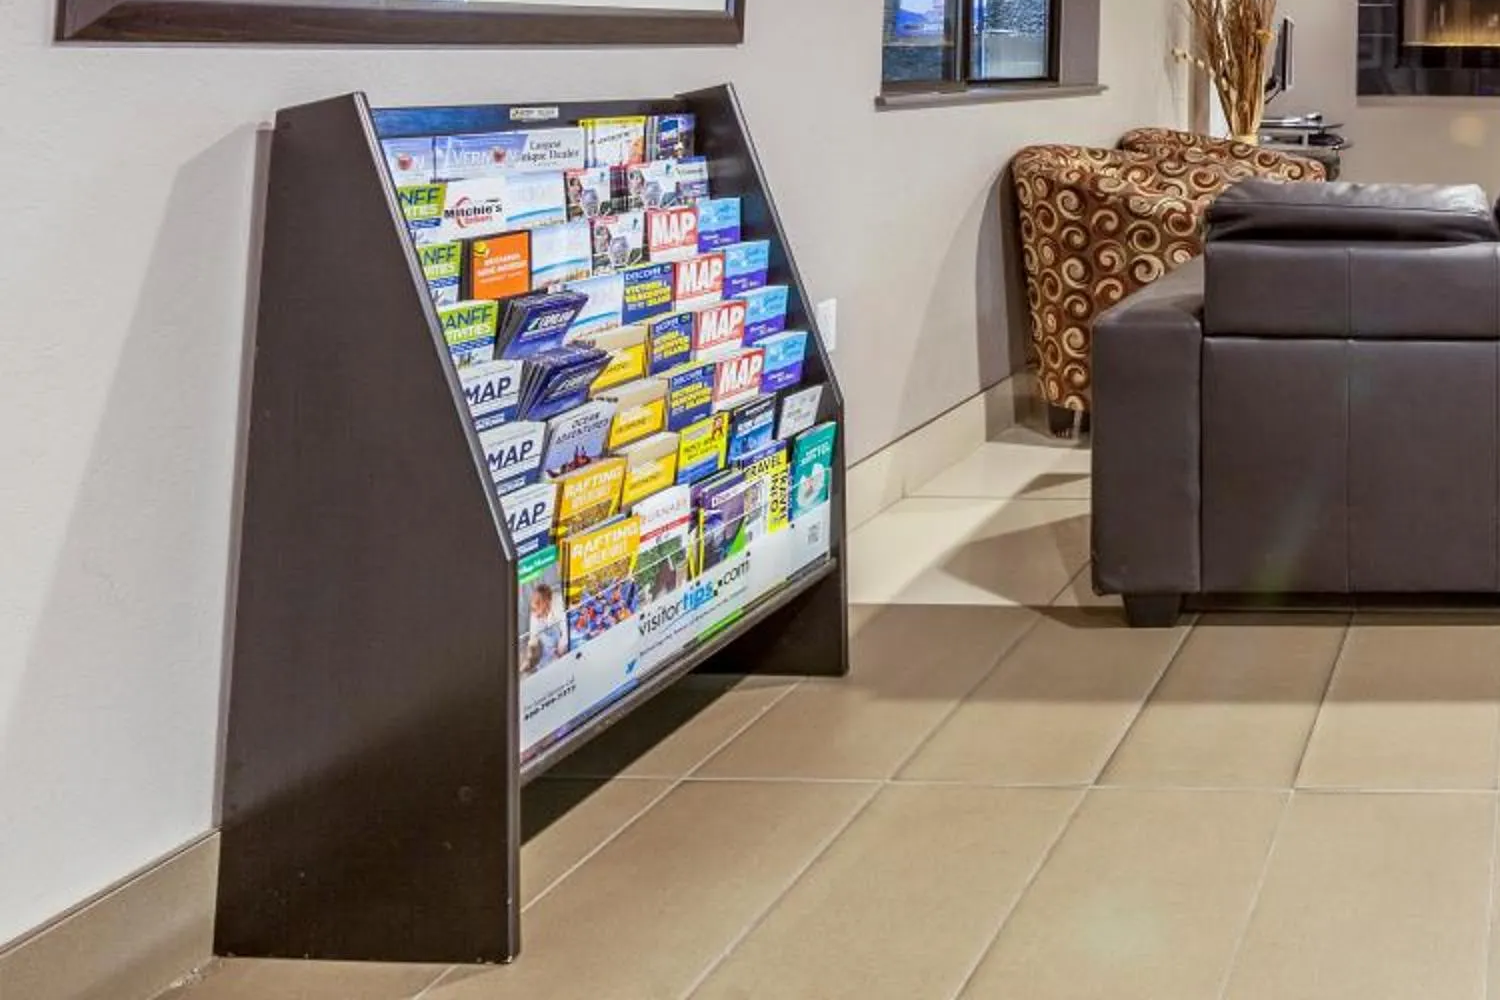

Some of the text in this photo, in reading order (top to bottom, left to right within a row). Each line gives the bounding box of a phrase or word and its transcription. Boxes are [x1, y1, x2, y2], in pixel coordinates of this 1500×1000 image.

[652, 213, 697, 248] MAP
[676, 260, 723, 297] MAP
[445, 303, 494, 329] ANFF
[701, 304, 746, 344] MAP
[465, 375, 512, 405] MAP
[718, 354, 763, 394] MAP
[487, 439, 534, 470] MAP
[571, 522, 640, 557] RAFTING
